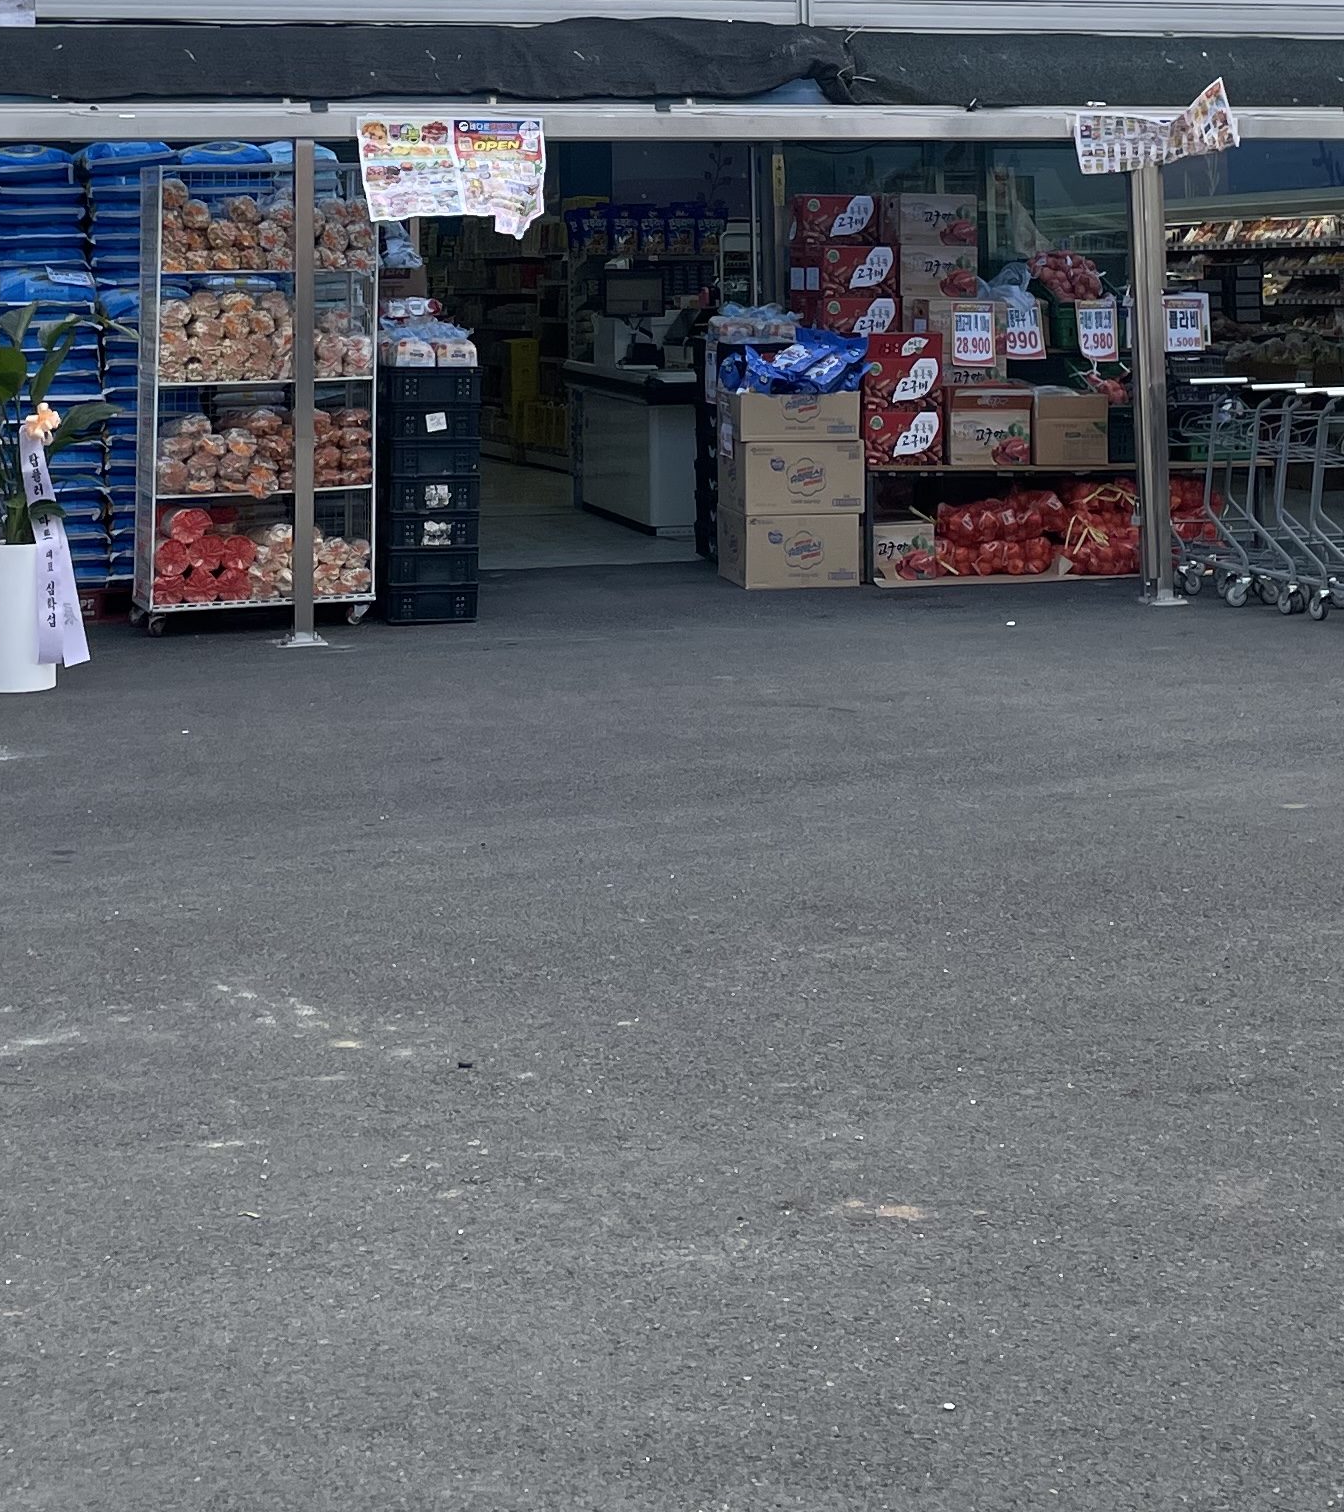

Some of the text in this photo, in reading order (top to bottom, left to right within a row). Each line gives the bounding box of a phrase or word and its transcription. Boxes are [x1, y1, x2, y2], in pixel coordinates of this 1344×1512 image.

[473, 140, 520, 152] OPEN
[857, 268, 884, 280] 고구마
[924, 260, 954, 278] 고구마
[956, 337, 991, 355] 28,900
[1082, 332, 1113, 350] 2,980
[902, 380, 928, 394] 고구마
[902, 435, 930, 447] 고구마
[975, 427, 1005, 446] 고구마
[878, 540, 908, 561] 고구마
